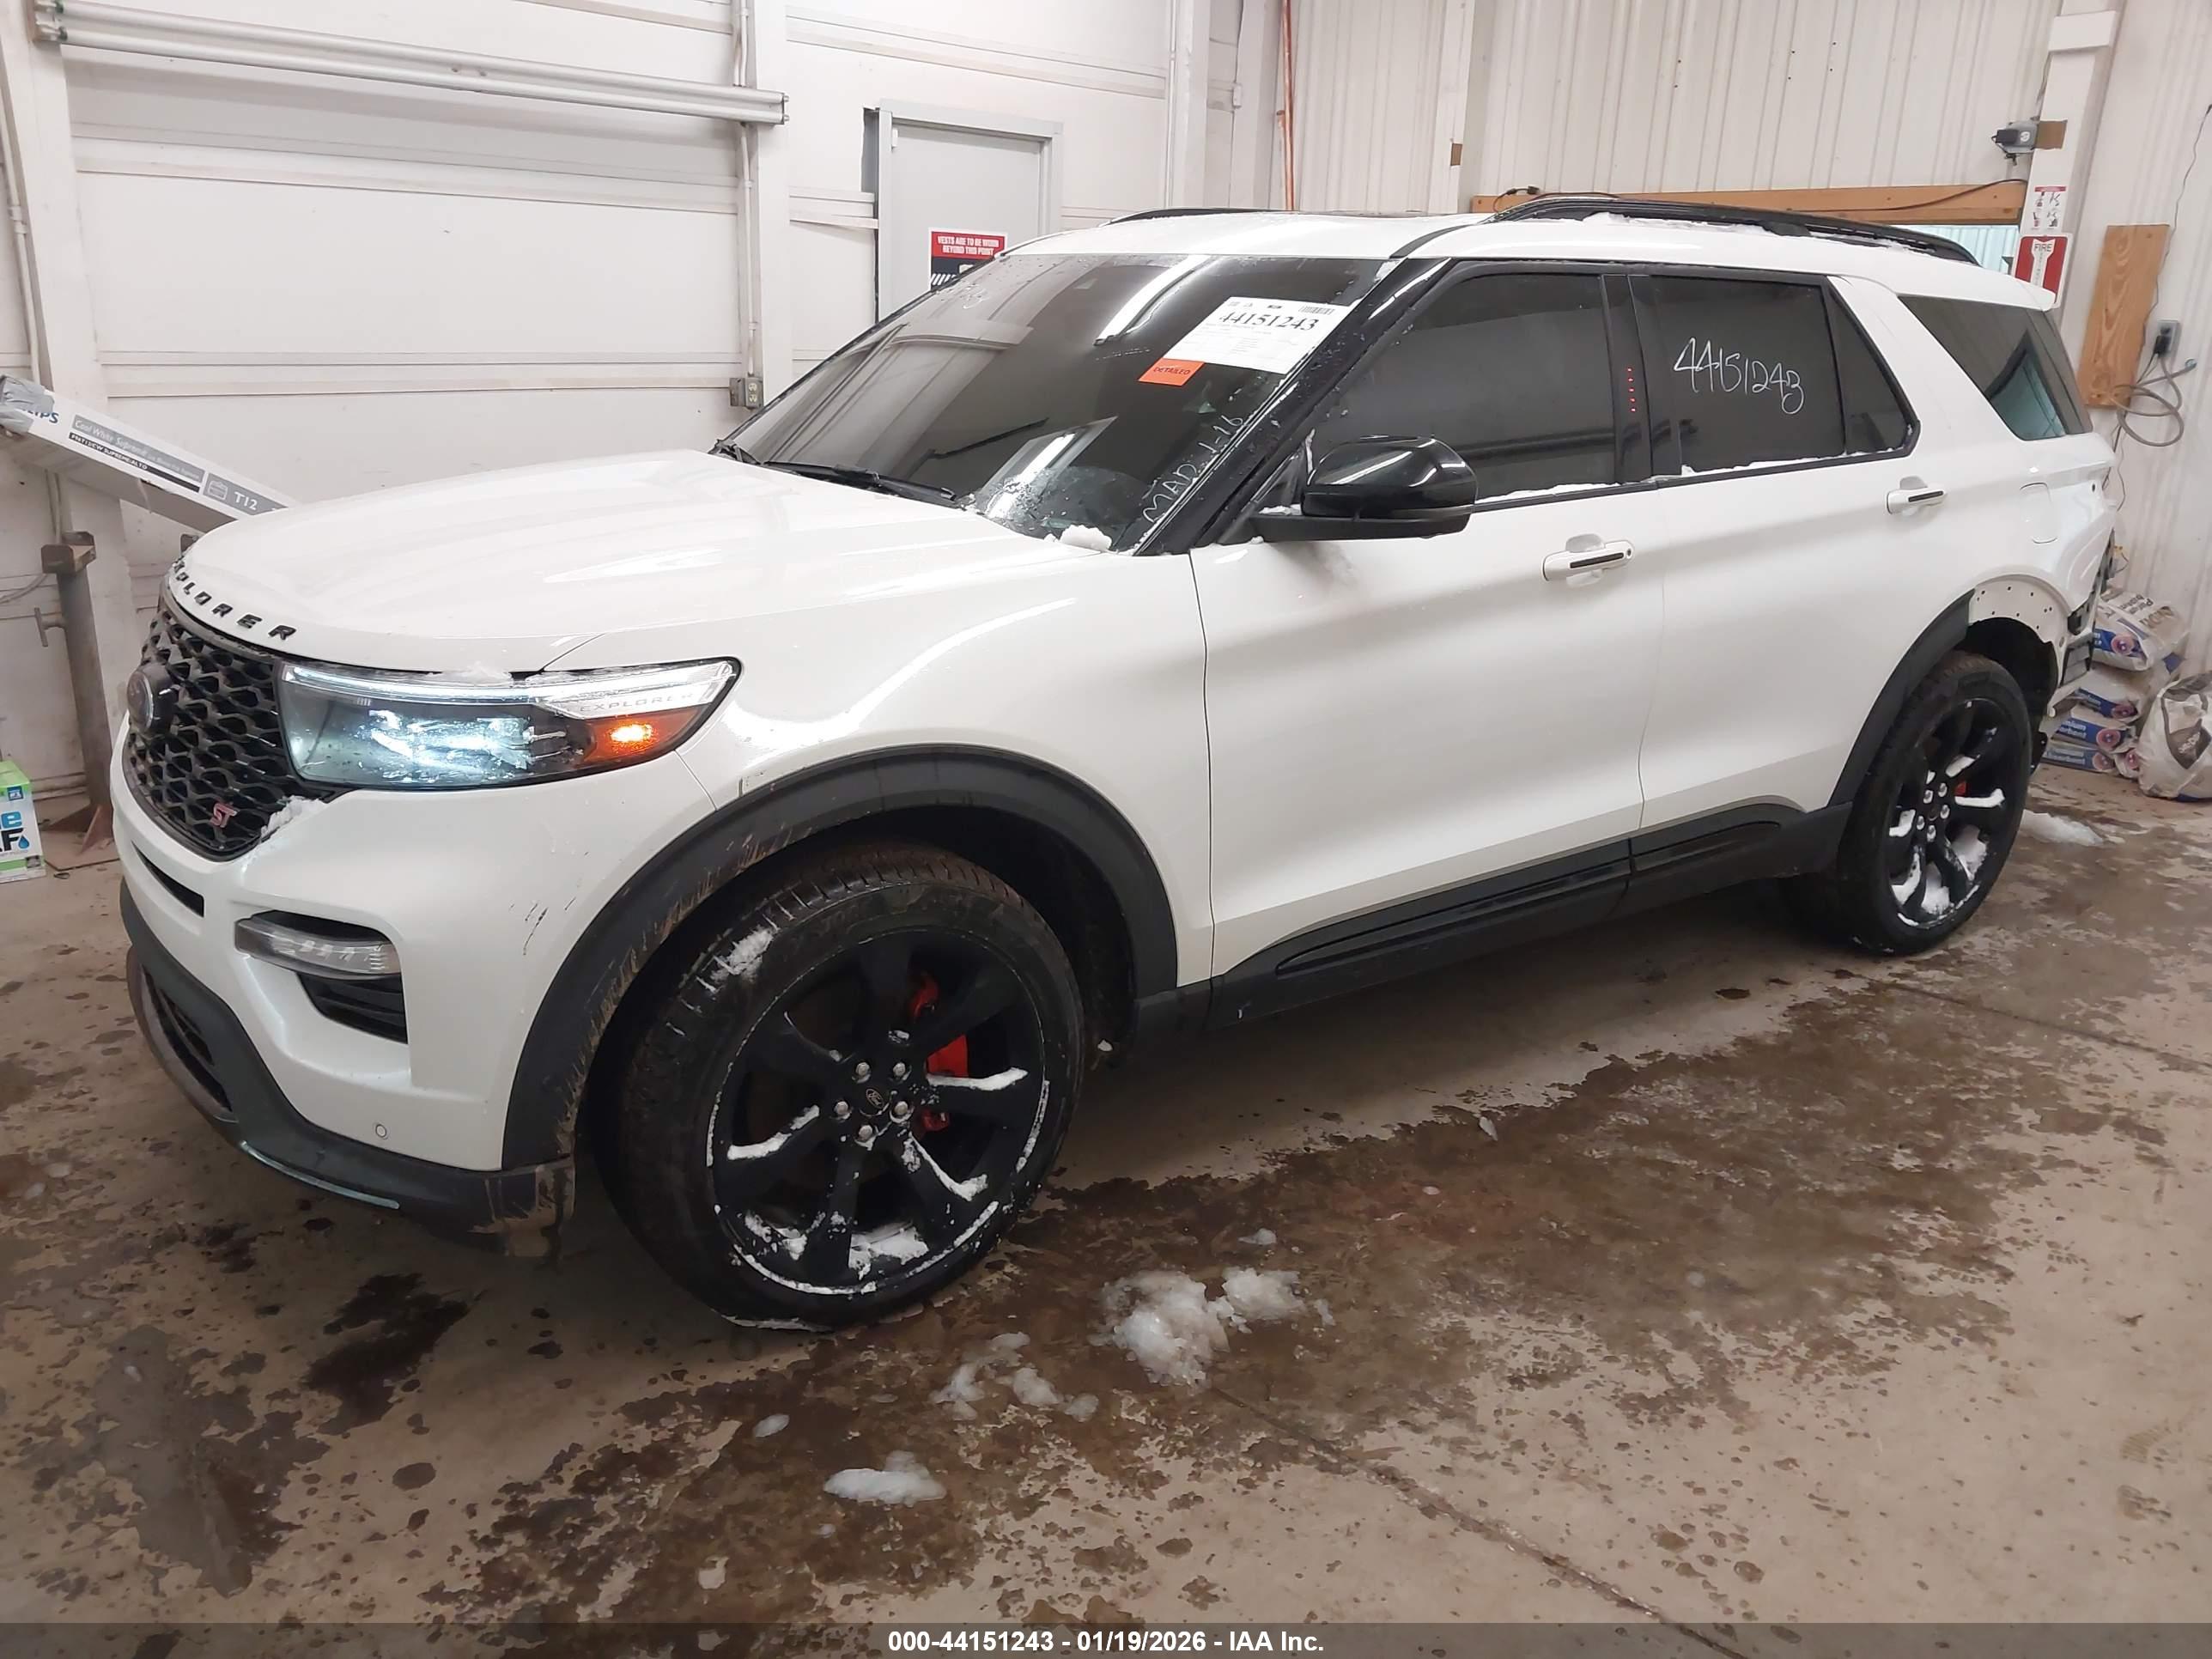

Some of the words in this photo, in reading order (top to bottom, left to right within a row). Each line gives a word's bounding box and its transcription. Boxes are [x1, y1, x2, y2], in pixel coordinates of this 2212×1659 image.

[2033, 243, 2053, 252] FIRE
[1218, 311, 1319, 331] 44151243
[1674, 337, 1804, 414] 44151243
[75, 419, 94, 433] Cool
[94, 428, 113, 442] White
[1143, 464, 1197, 522] MAD
[1198, 415, 1243, 453] 1-16
[234, 491, 258, 511] T12
[173, 556, 296, 641] XPLORER
[210, 801, 239, 828] ST
